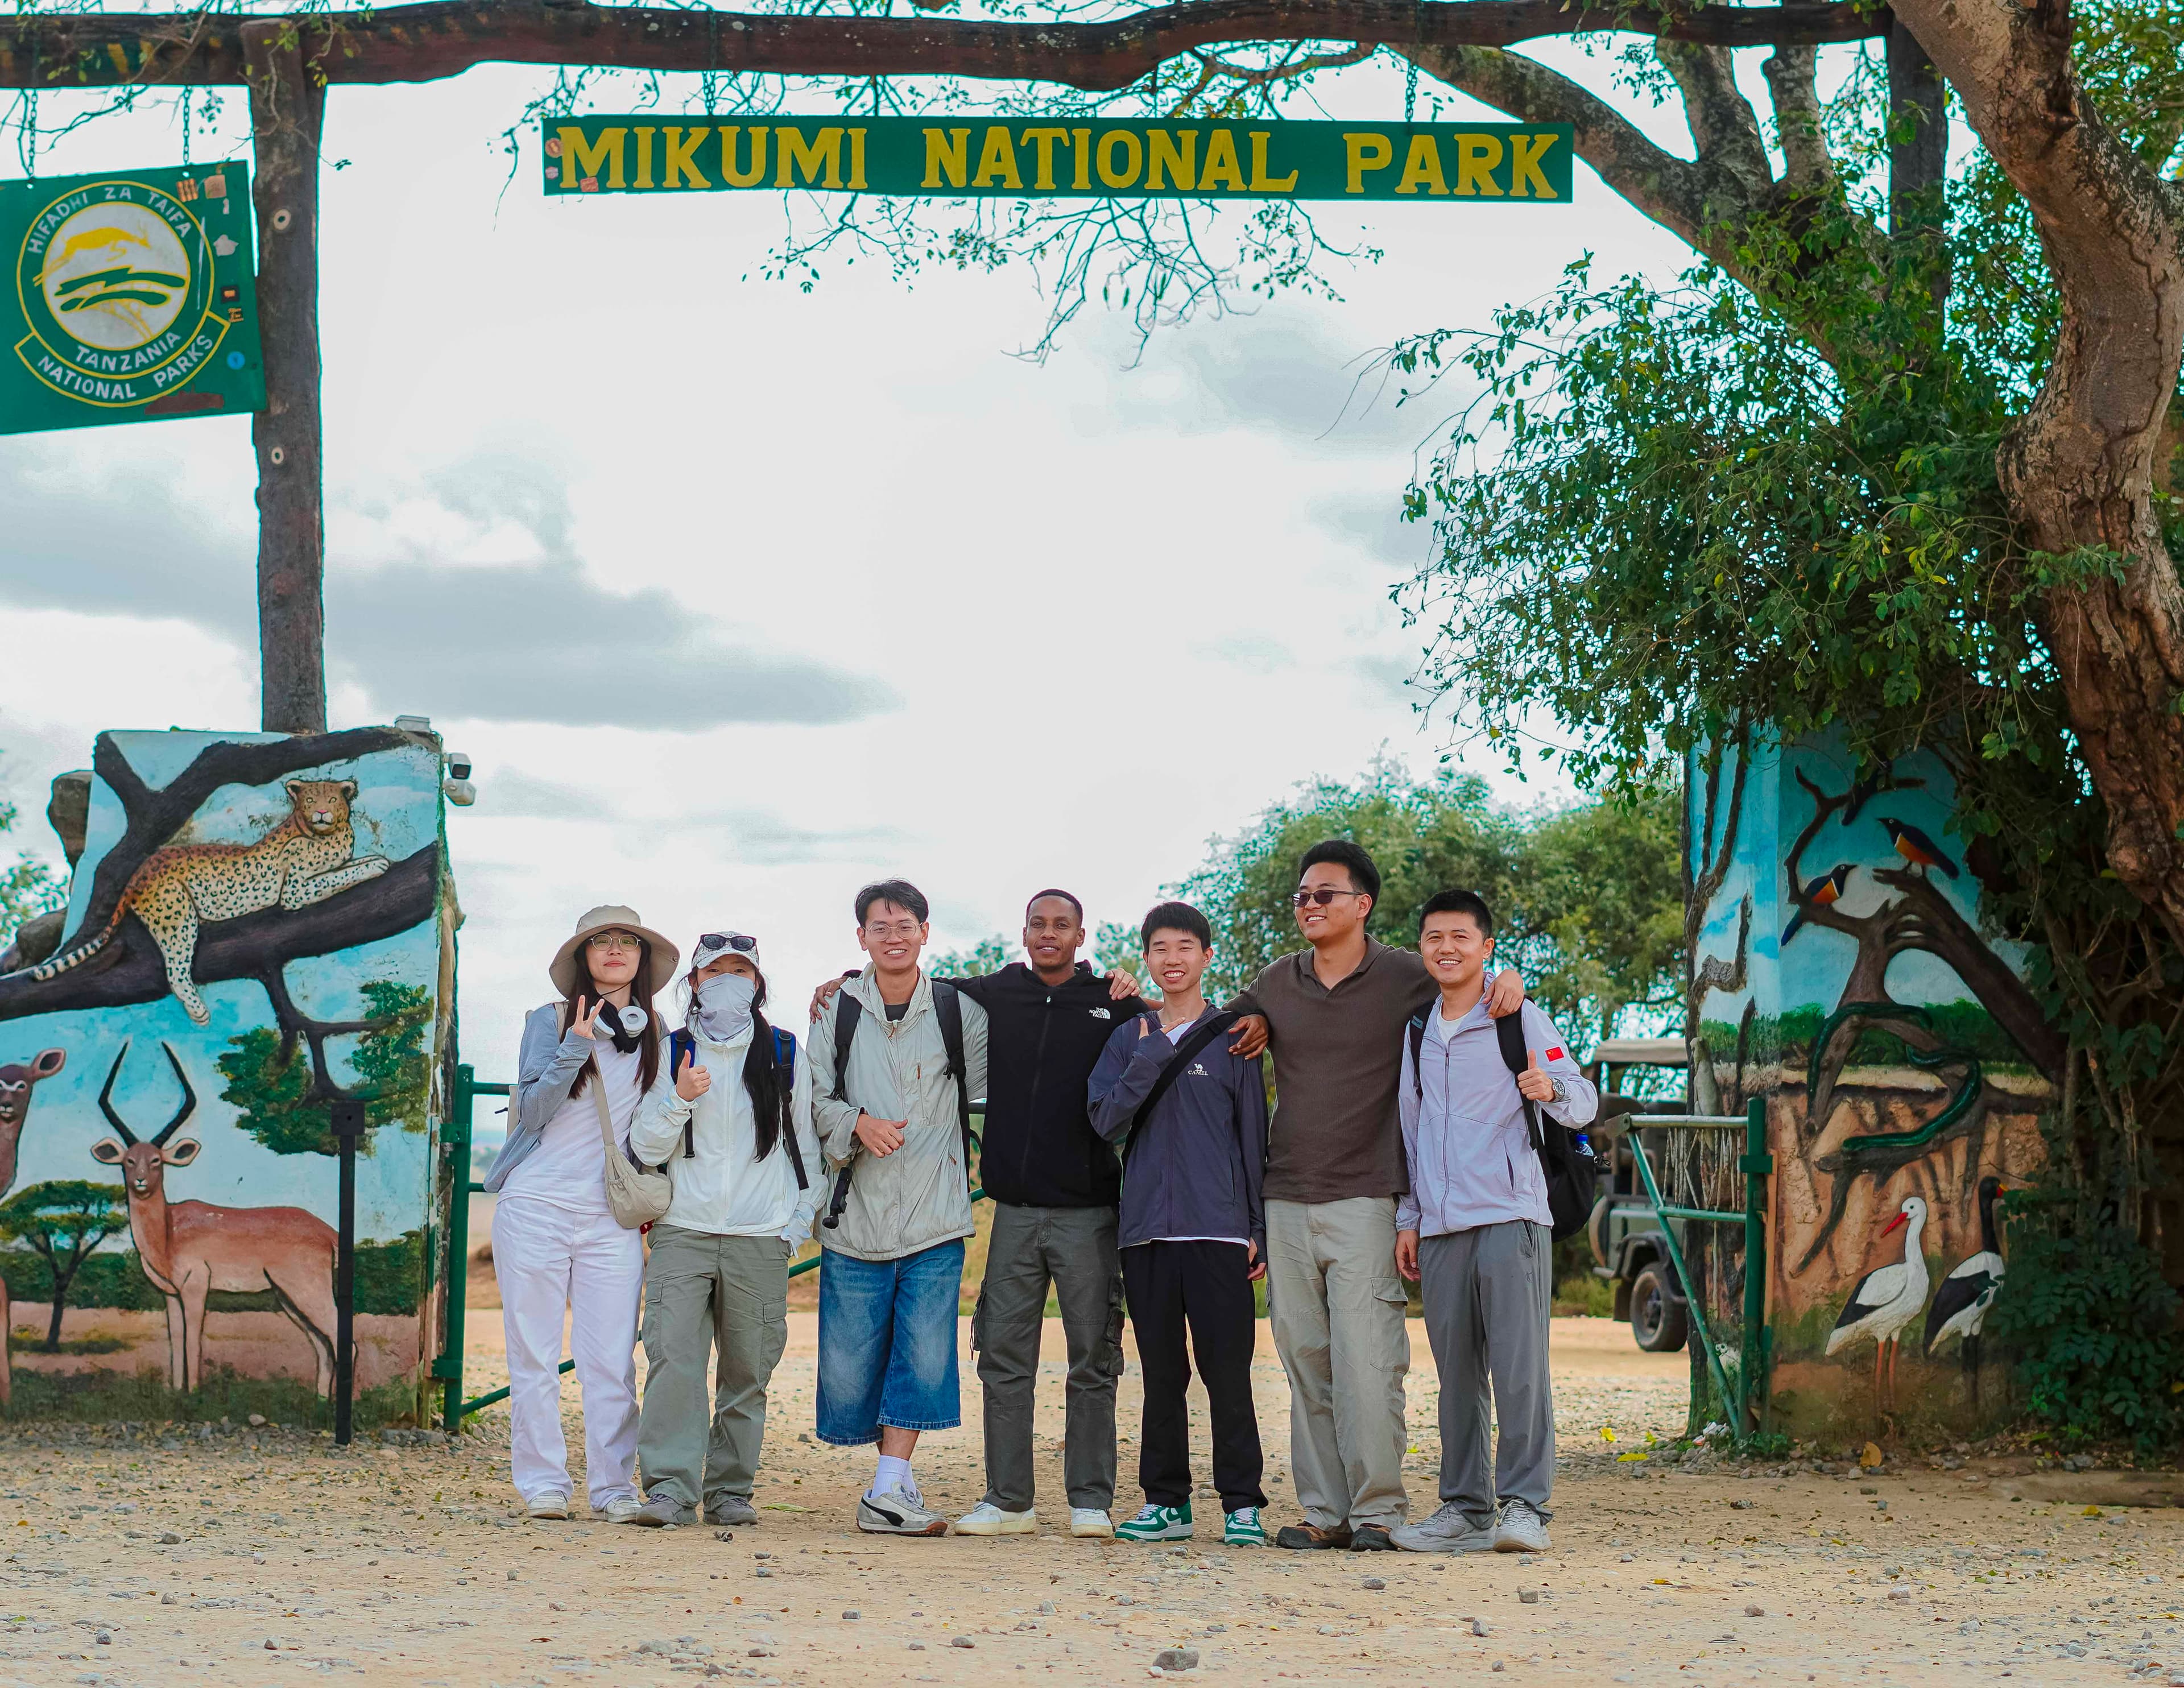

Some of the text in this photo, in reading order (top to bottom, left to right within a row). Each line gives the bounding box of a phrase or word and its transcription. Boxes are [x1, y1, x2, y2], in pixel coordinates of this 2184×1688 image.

[556, 126, 1560, 199] MIKUMI NATIONAL PARK
[27, 192, 88, 254] HIFADHI
[104, 187, 131, 200] ZA
[148, 191, 192, 239] TAIFA
[38, 334, 214, 400] NATIONAL PARKS
[75, 332, 182, 373] TANZANIA
